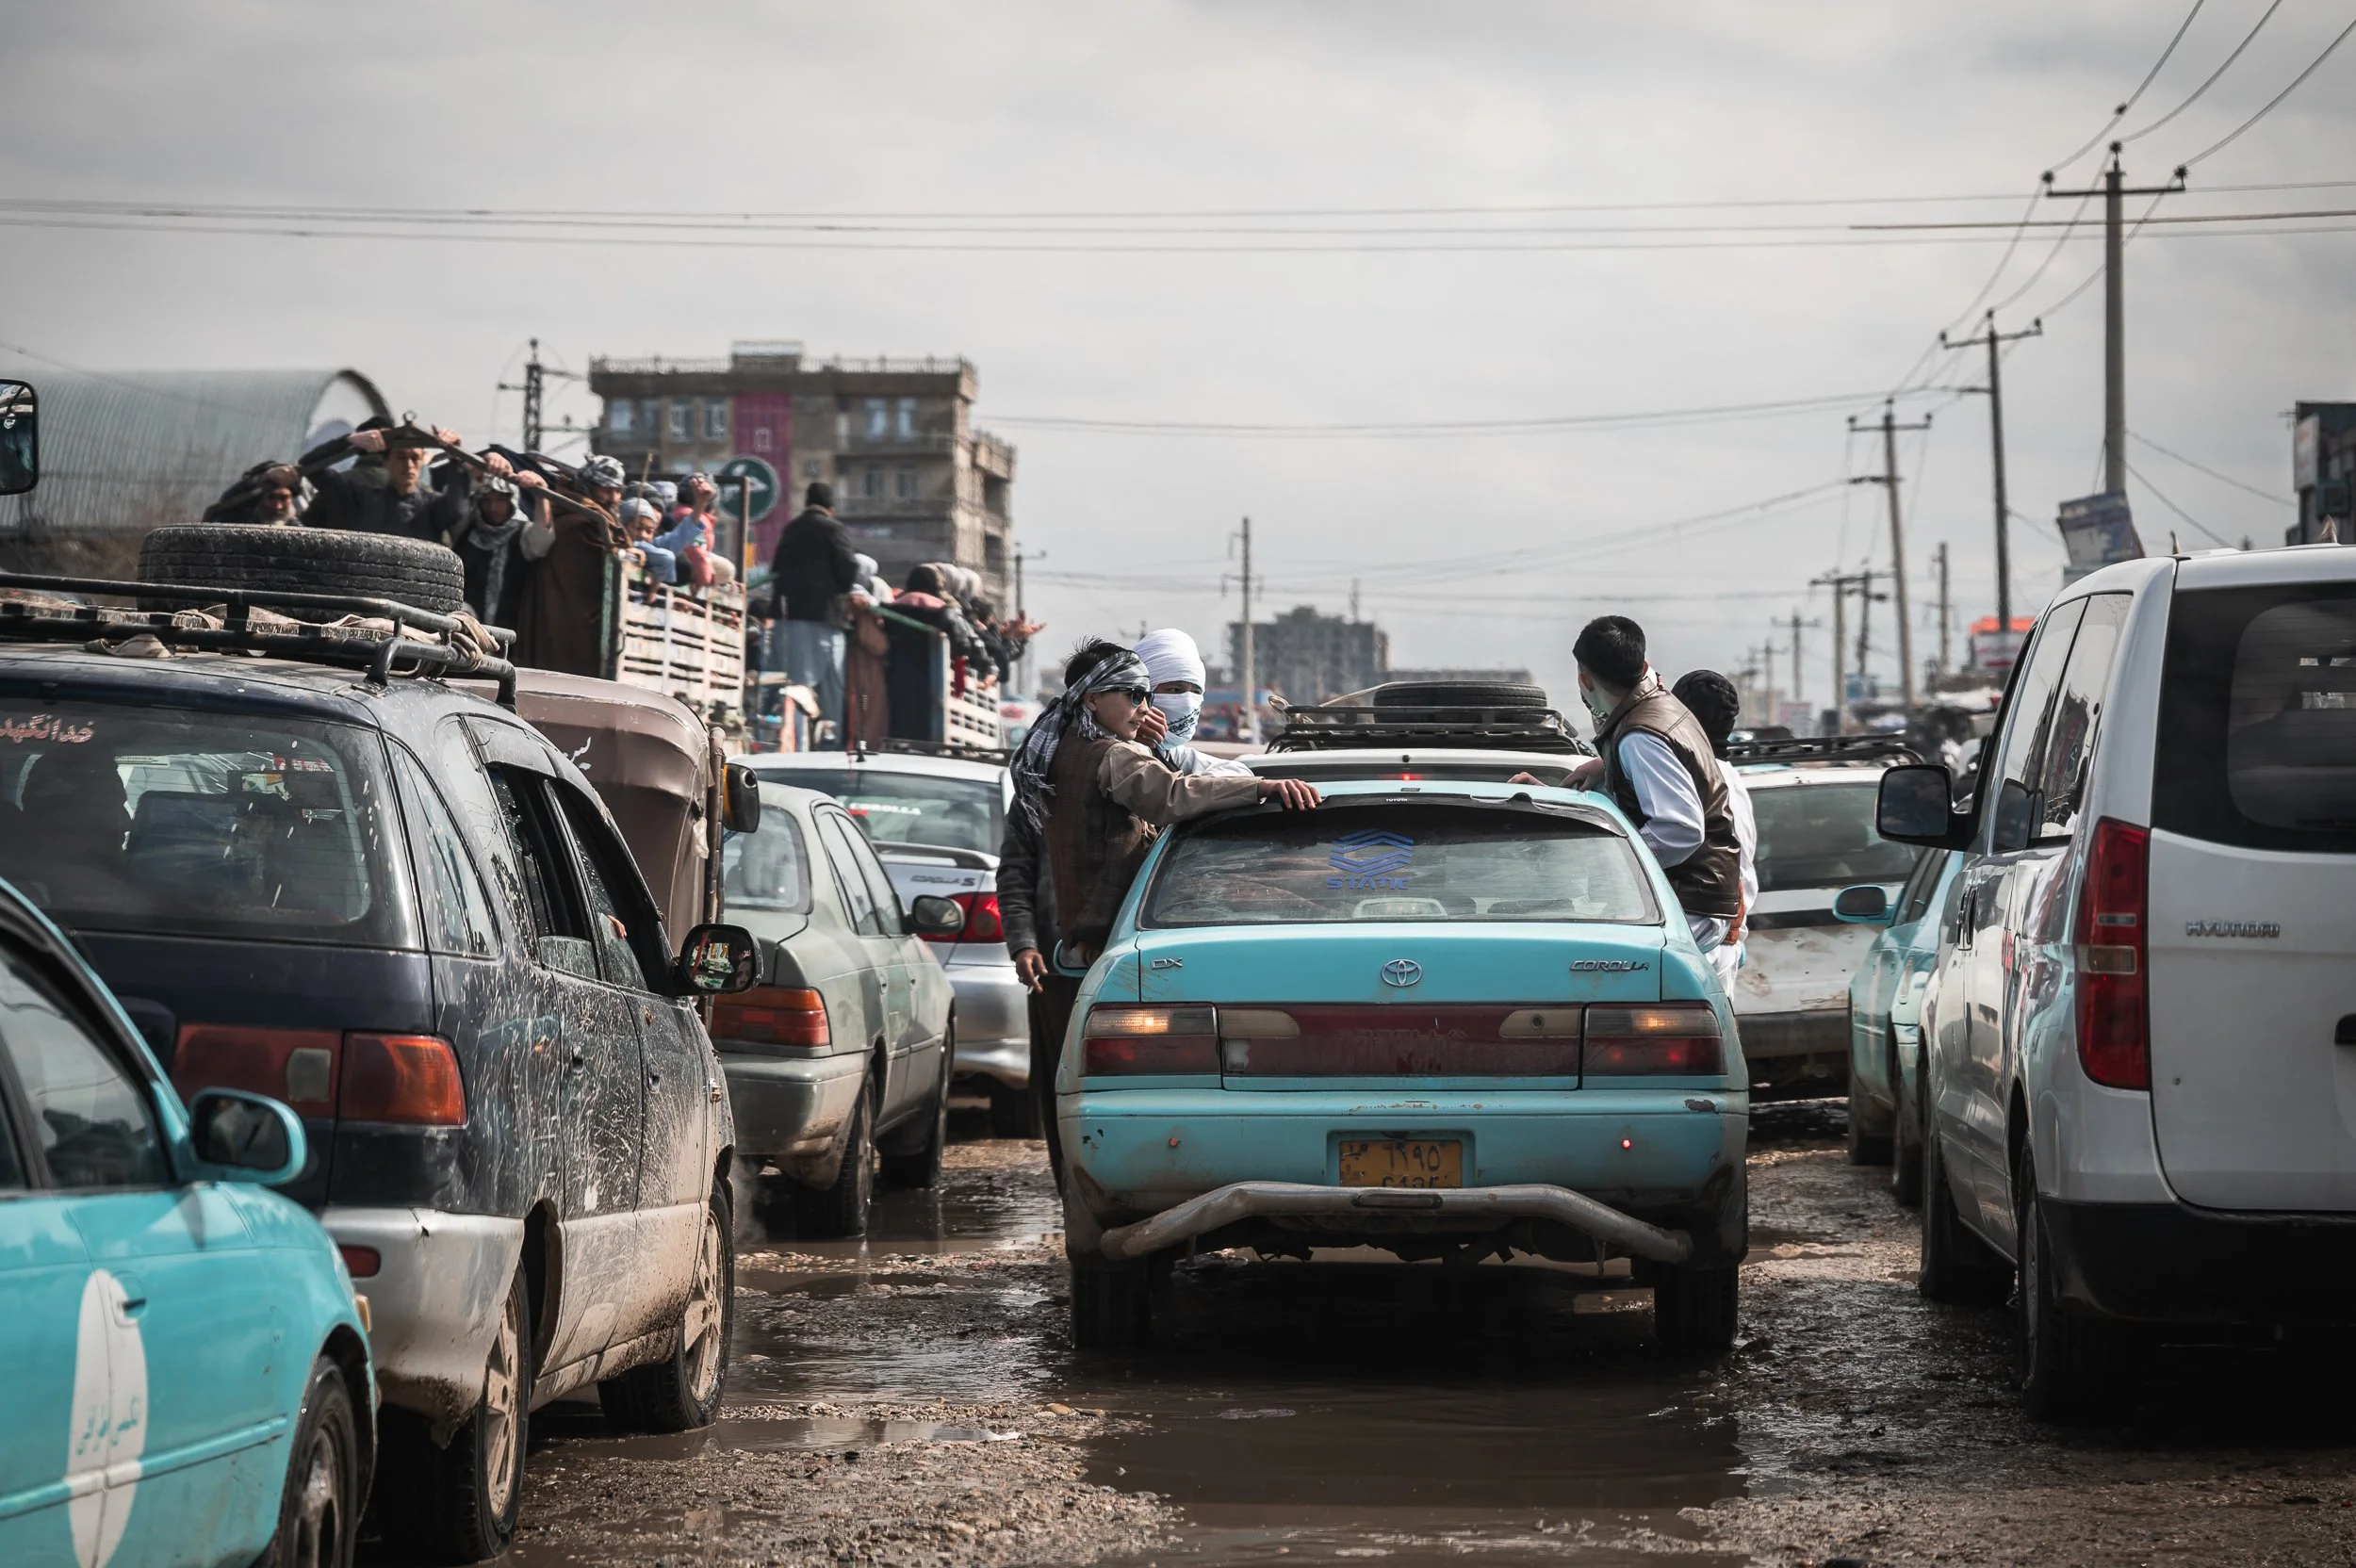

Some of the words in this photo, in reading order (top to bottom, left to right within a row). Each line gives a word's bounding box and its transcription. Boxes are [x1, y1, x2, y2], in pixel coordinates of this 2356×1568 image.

[1326, 875, 1412, 890] STATIC
[2185, 921, 2281, 939] HYUNDAI
[1152, 957, 1184, 970] DX
[1570, 960, 1650, 972] COROLLA
